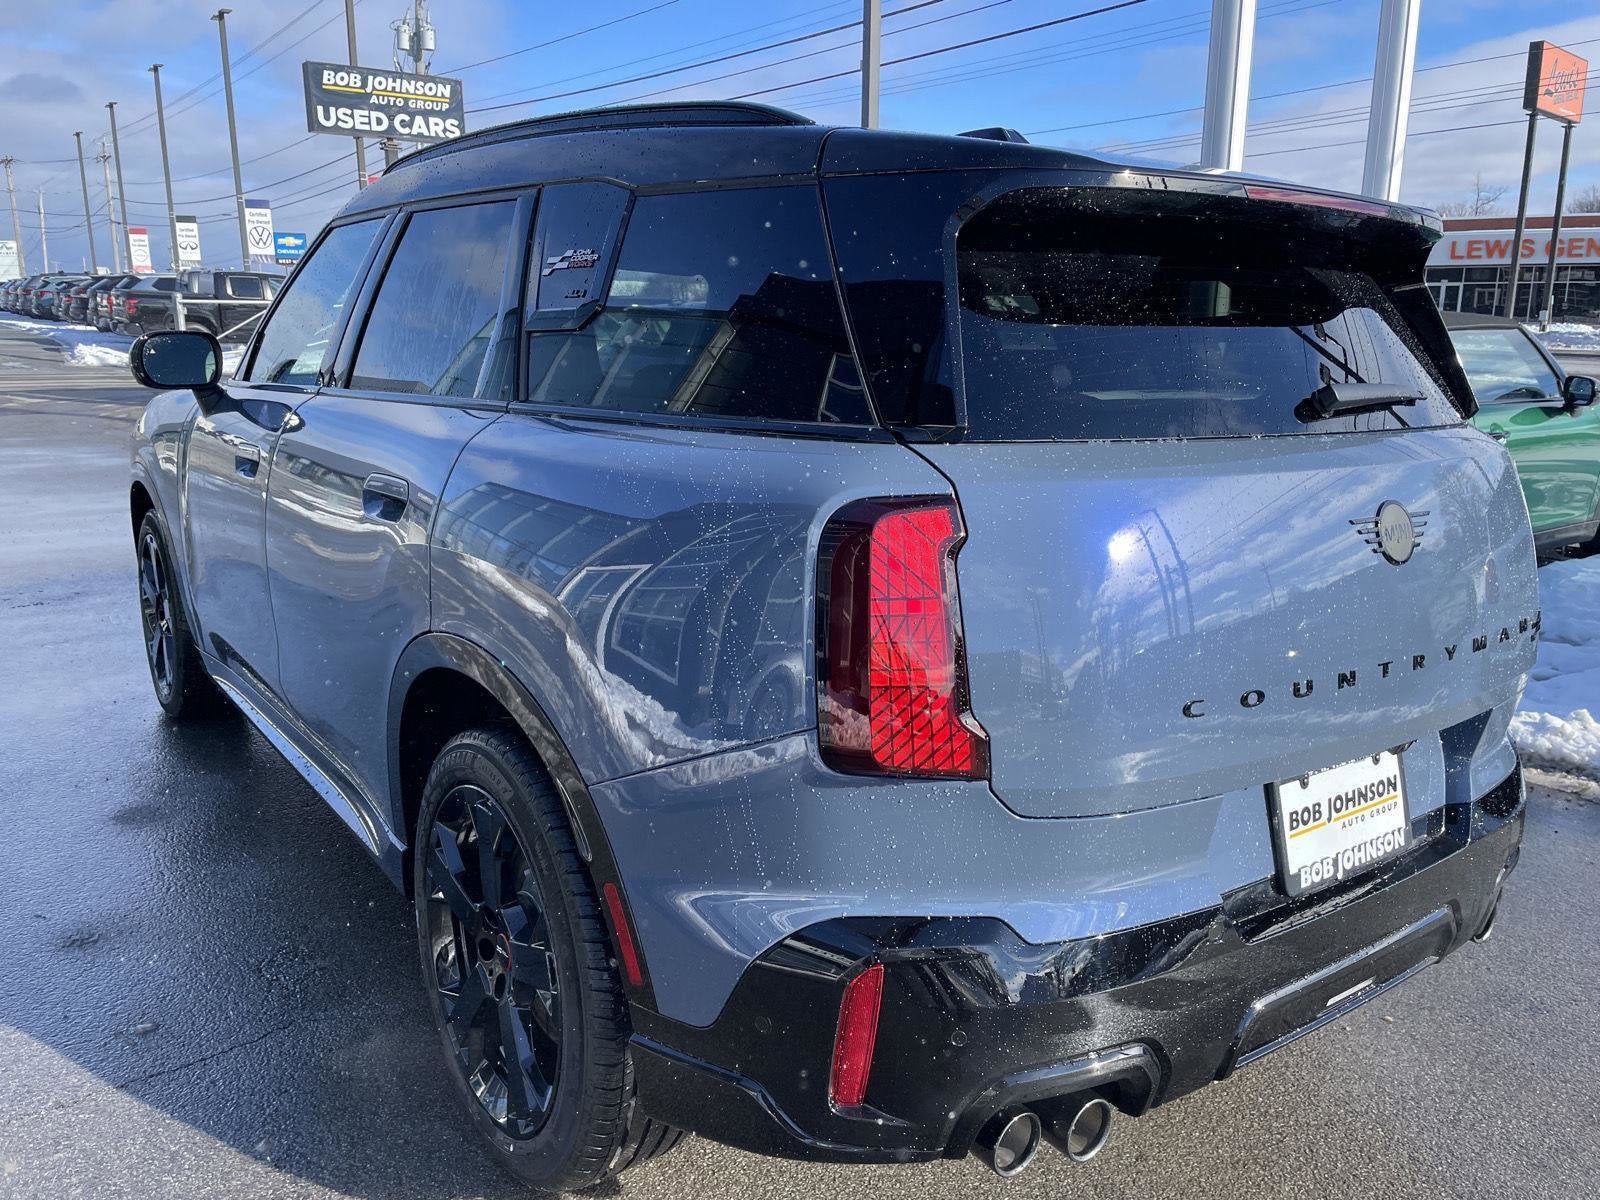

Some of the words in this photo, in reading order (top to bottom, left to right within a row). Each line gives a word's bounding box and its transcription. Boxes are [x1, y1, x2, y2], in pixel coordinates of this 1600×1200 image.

[322, 69, 362, 88] BOB
[364, 75, 452, 98] JOHNSON
[369, 94, 404, 107] AUTO
[408, 99, 450, 112] GROUP
[316, 105, 389, 132] USED
[393, 113, 461, 139] CARS
[1449, 238, 1536, 260] LEWS
[1383, 522, 1410, 544] MINI
[1181, 617, 1529, 719] COUNTRYMAN
[1288, 801, 1323, 831] BOB
[1326, 774, 1398, 824] JOHNSON
[1341, 814, 1366, 830] AUTO
[1369, 801, 1399, 818] GROUP
[1300, 860, 1335, 889] BOB
[1336, 828, 1405, 880] JOHNSON
